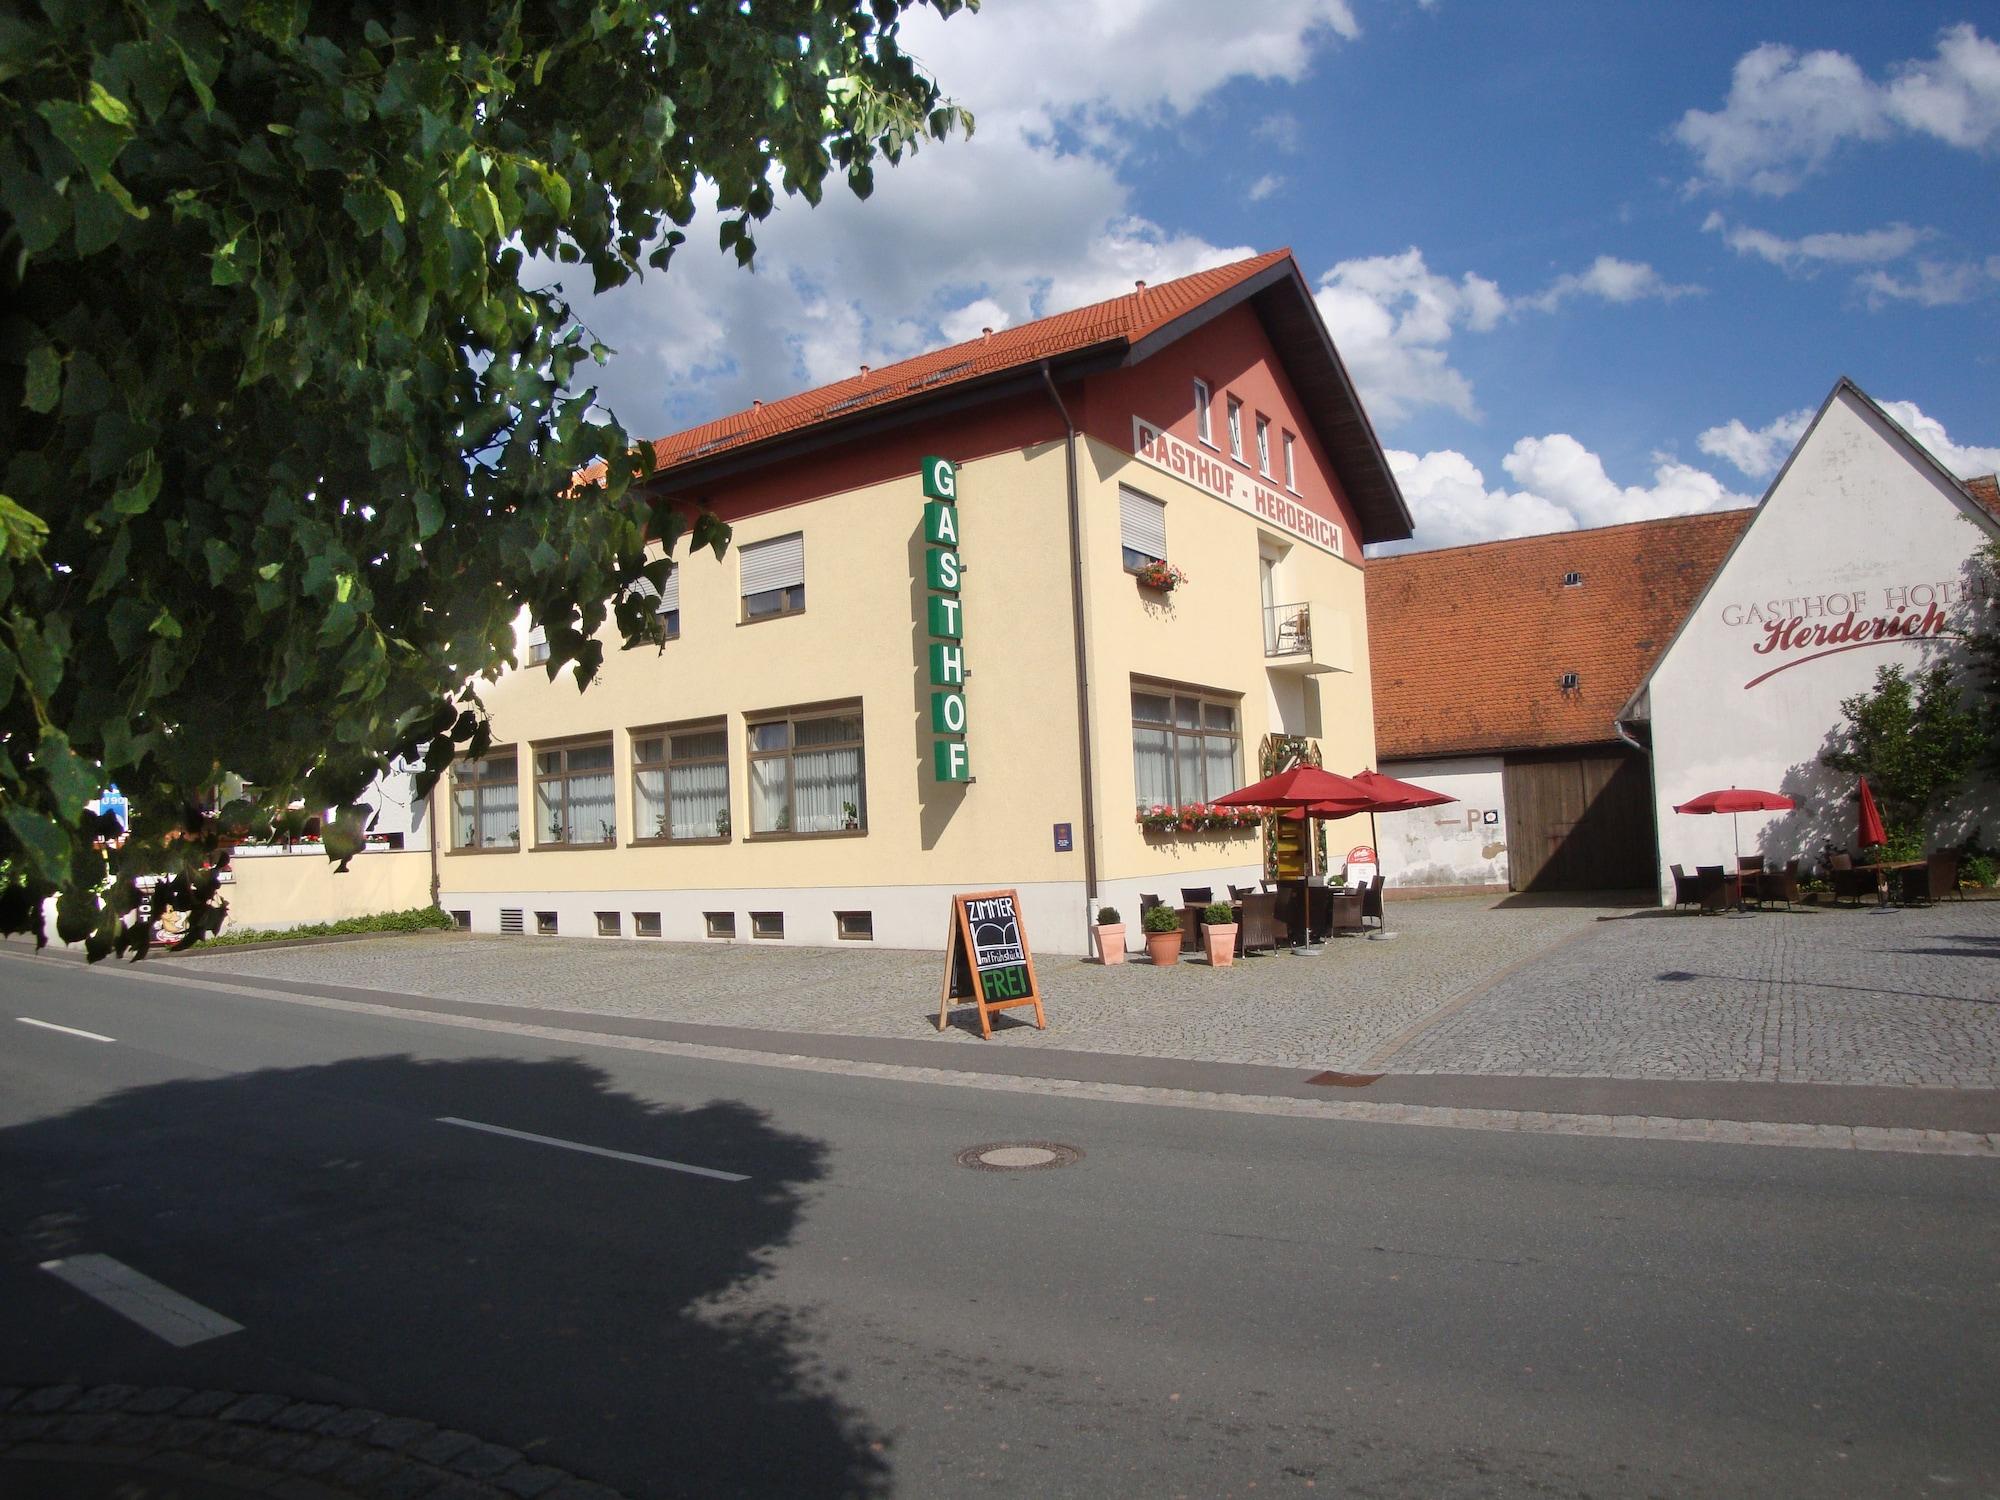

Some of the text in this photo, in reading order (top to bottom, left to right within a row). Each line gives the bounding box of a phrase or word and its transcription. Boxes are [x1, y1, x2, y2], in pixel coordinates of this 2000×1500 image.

[1140, 425, 1234, 498] GASTHOF
[1254, 485, 1339, 552] HERDERICH
[934, 460, 965, 779] GASTHOF
[1721, 590, 1866, 626] GASTHOF
[1753, 602, 1946, 654] Herderich
[1467, 809, 1481, 832] P
[966, 897, 1016, 921] ZIMMER
[981, 965, 1027, 999] FREI
